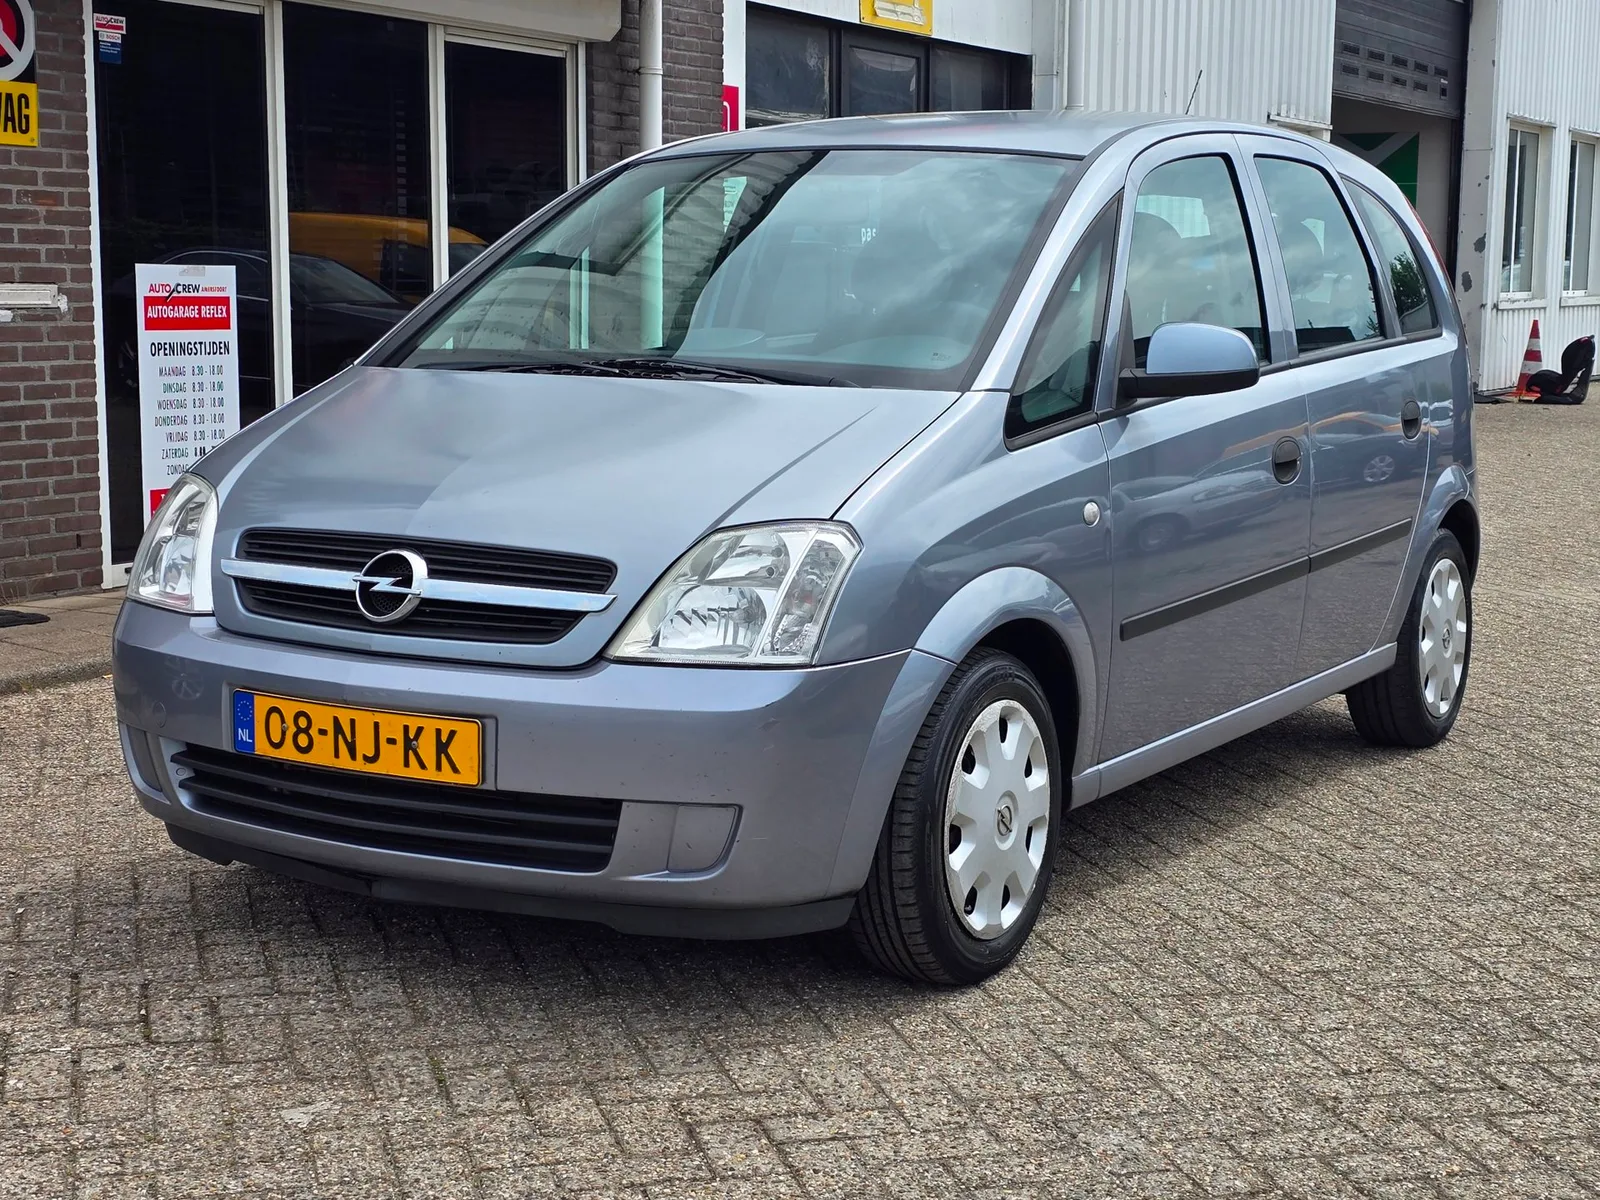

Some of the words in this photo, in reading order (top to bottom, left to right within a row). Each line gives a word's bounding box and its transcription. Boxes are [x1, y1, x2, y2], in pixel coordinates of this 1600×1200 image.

[147, 306, 199, 318] AUTOGARAGE
[201, 306, 227, 318] REFLEX
[150, 341, 230, 356] OPENINGSTIJDEN
[158, 366, 186, 377] MAANDAG
[192, 366, 203, 376] 8.30
[209, 365, 223, 376] 18.00
[162, 383, 186, 393] DINSDAG
[192, 382, 204, 392] 8.30
[210, 381, 224, 392] 18.00
[157, 399, 187, 410] WOENSDAG
[193, 398, 204, 408] 8.30
[210, 397, 224, 408] 18.00
[155, 415, 188, 427] DONDERDAG
[193, 414, 204, 424] 8.30
[211, 413, 224, 423] 18.00
[166, 431, 188, 442] VRIJDAG
[194, 431, 205, 441] 8.30
[211, 429, 225, 440] 18.00
[162, 448, 189, 459] ZATERDAG
[238, 728, 252, 742] NL
[264, 706, 461, 774] 08-NJ-KK
